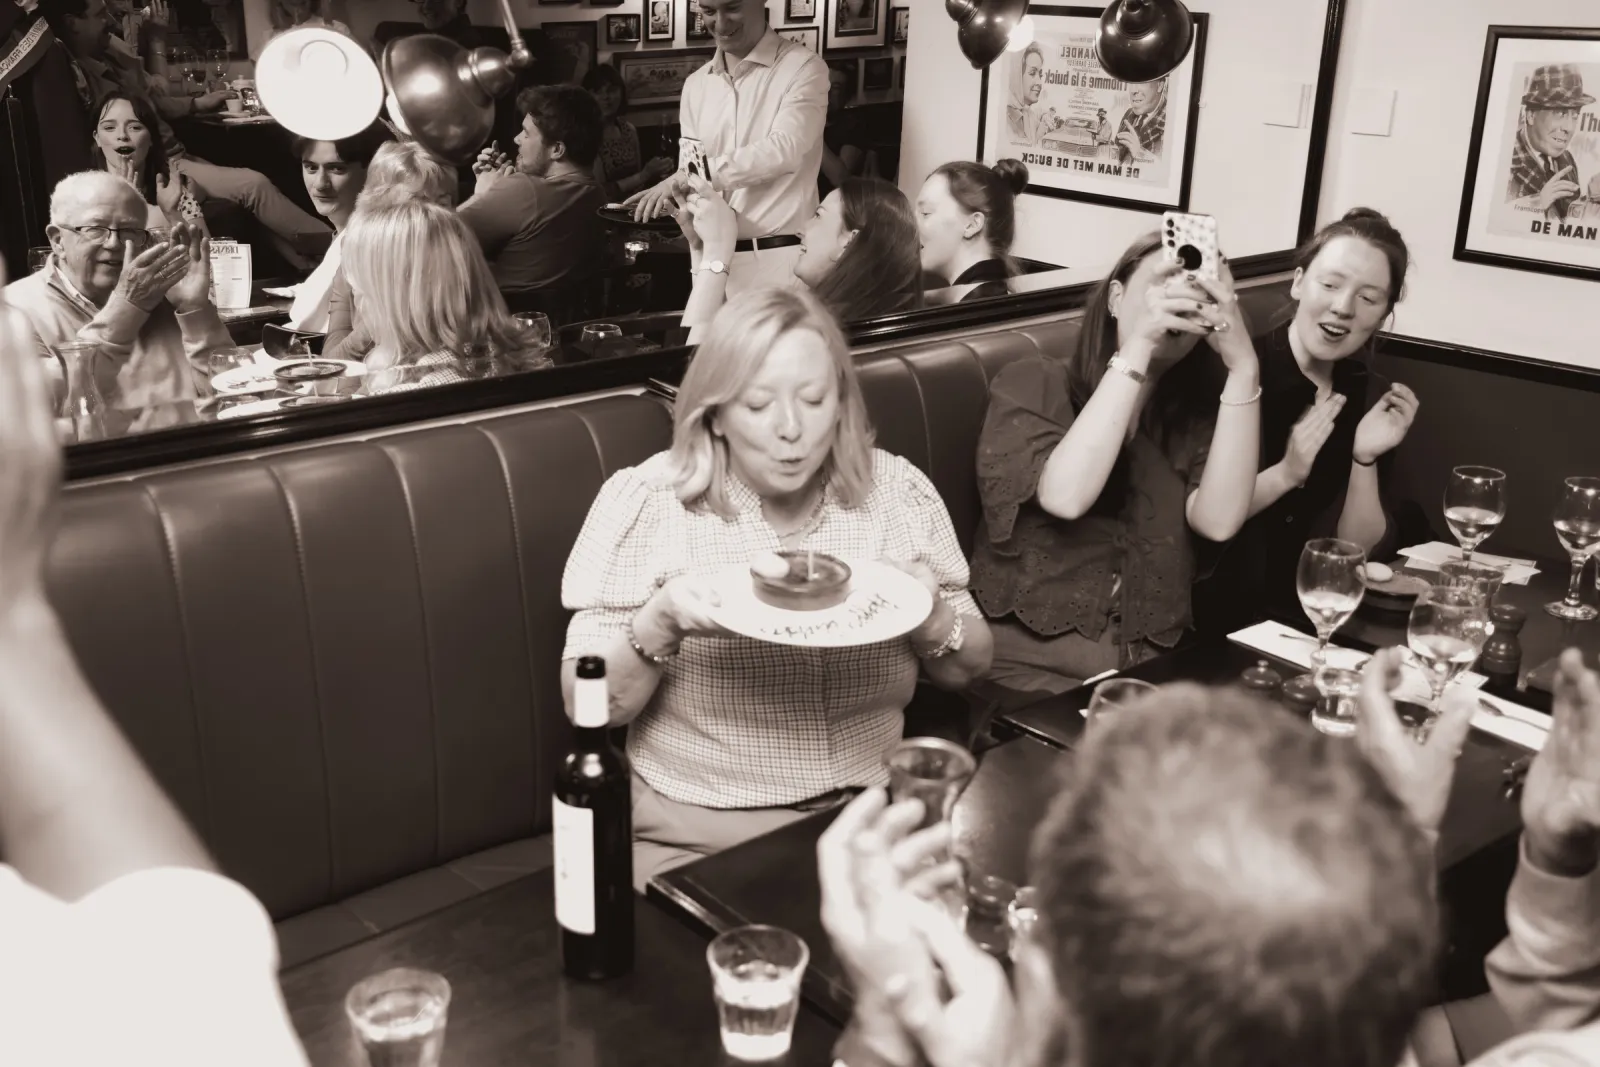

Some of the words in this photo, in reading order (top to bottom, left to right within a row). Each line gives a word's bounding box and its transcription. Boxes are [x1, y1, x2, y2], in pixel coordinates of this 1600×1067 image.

[1580, 112, 1600, 132] l'h
[1531, 220, 1551, 235] DE
[1557, 223, 1598, 241] MAN
